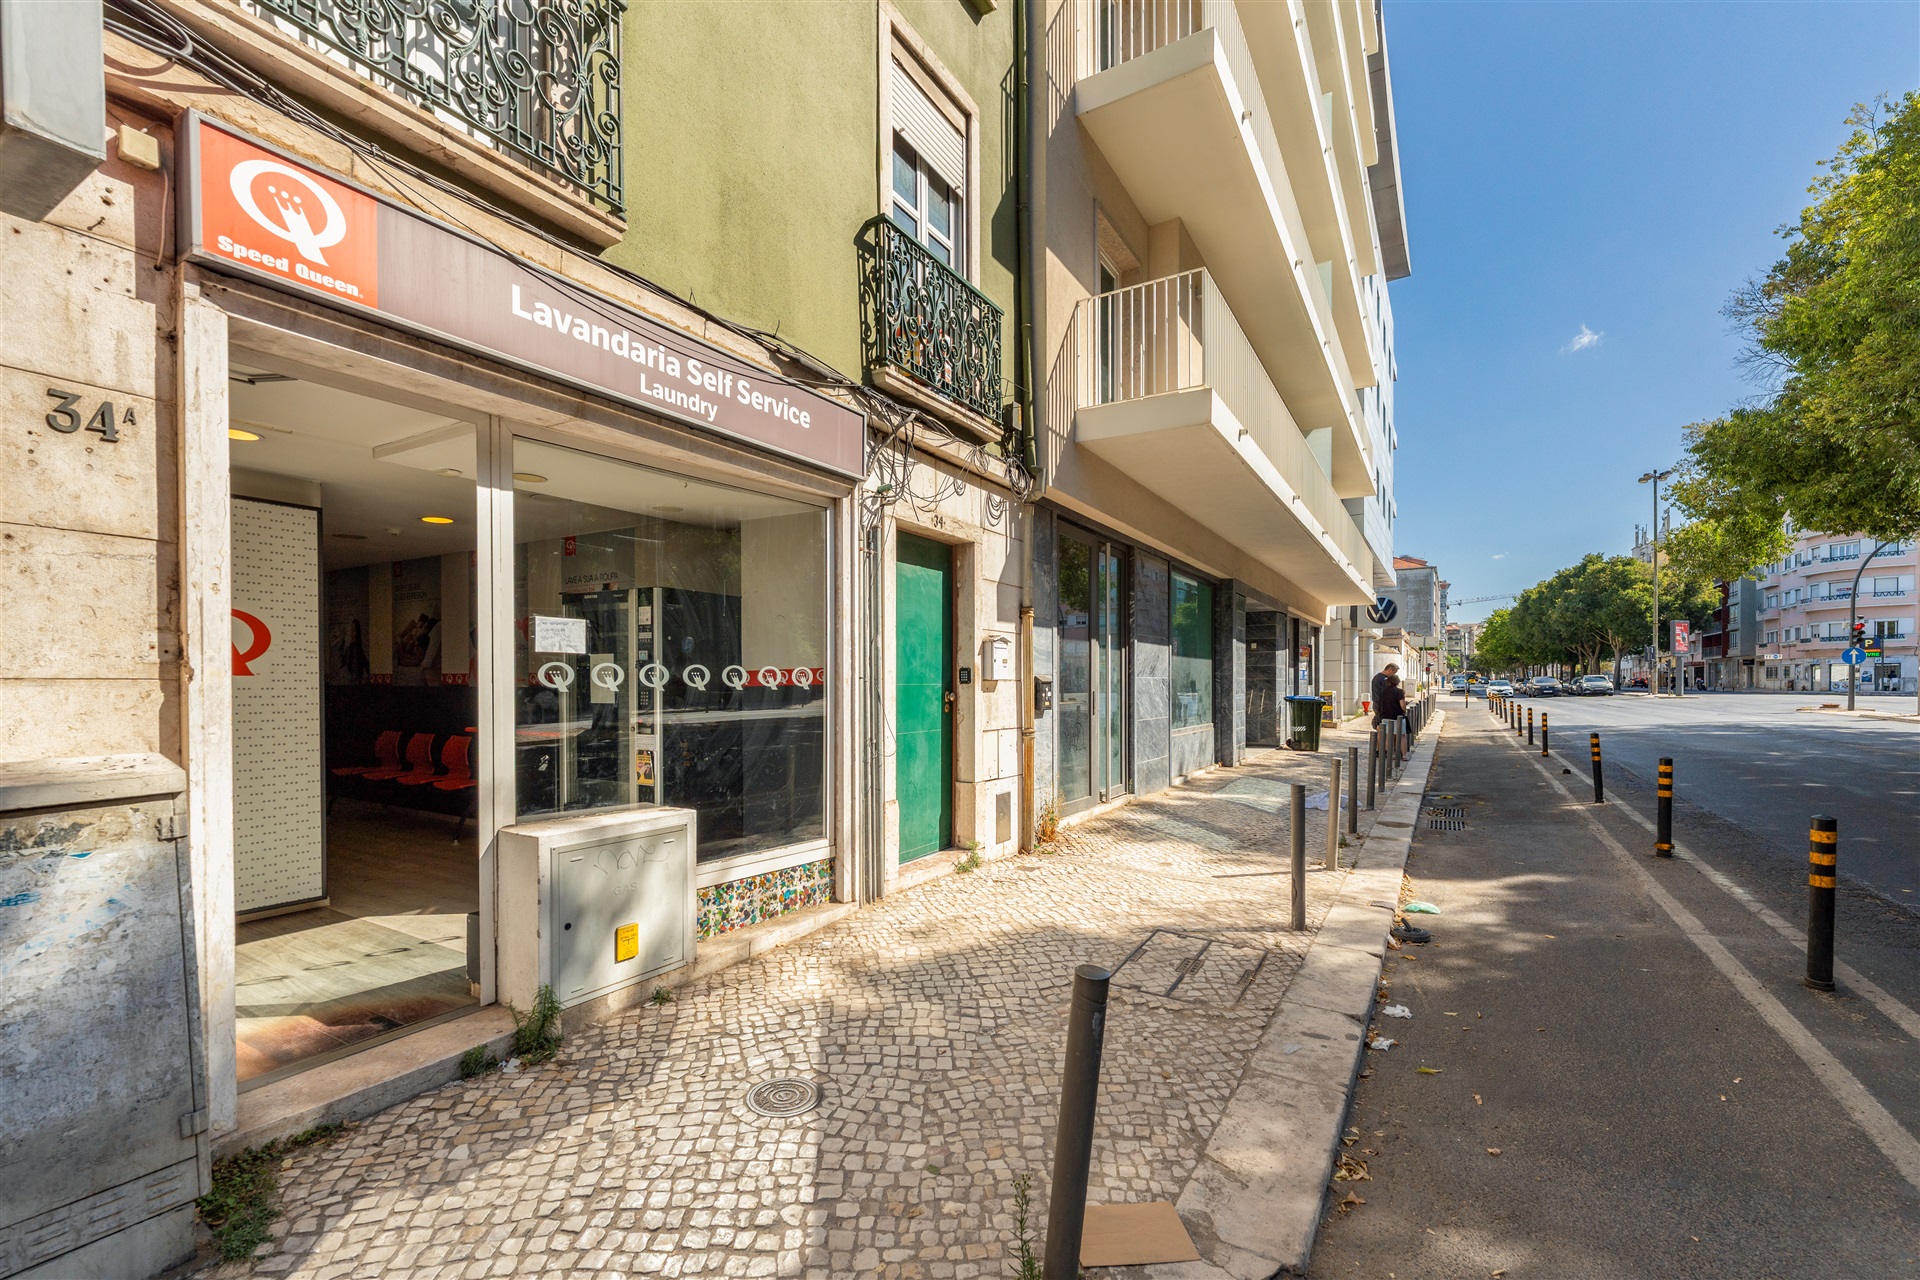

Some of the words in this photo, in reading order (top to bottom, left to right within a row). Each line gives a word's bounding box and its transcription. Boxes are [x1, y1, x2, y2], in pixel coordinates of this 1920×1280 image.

[217, 235, 289, 273] Speed
[295, 262, 359, 297] Queen
[511, 284, 681, 379] Lavandaria
[687, 357, 733, 399] Self
[737, 379, 812, 429] Service
[640, 373, 719, 423] Laundry
[1864, 639, 1874, 648] P
[613, 882, 638, 896] GAS
